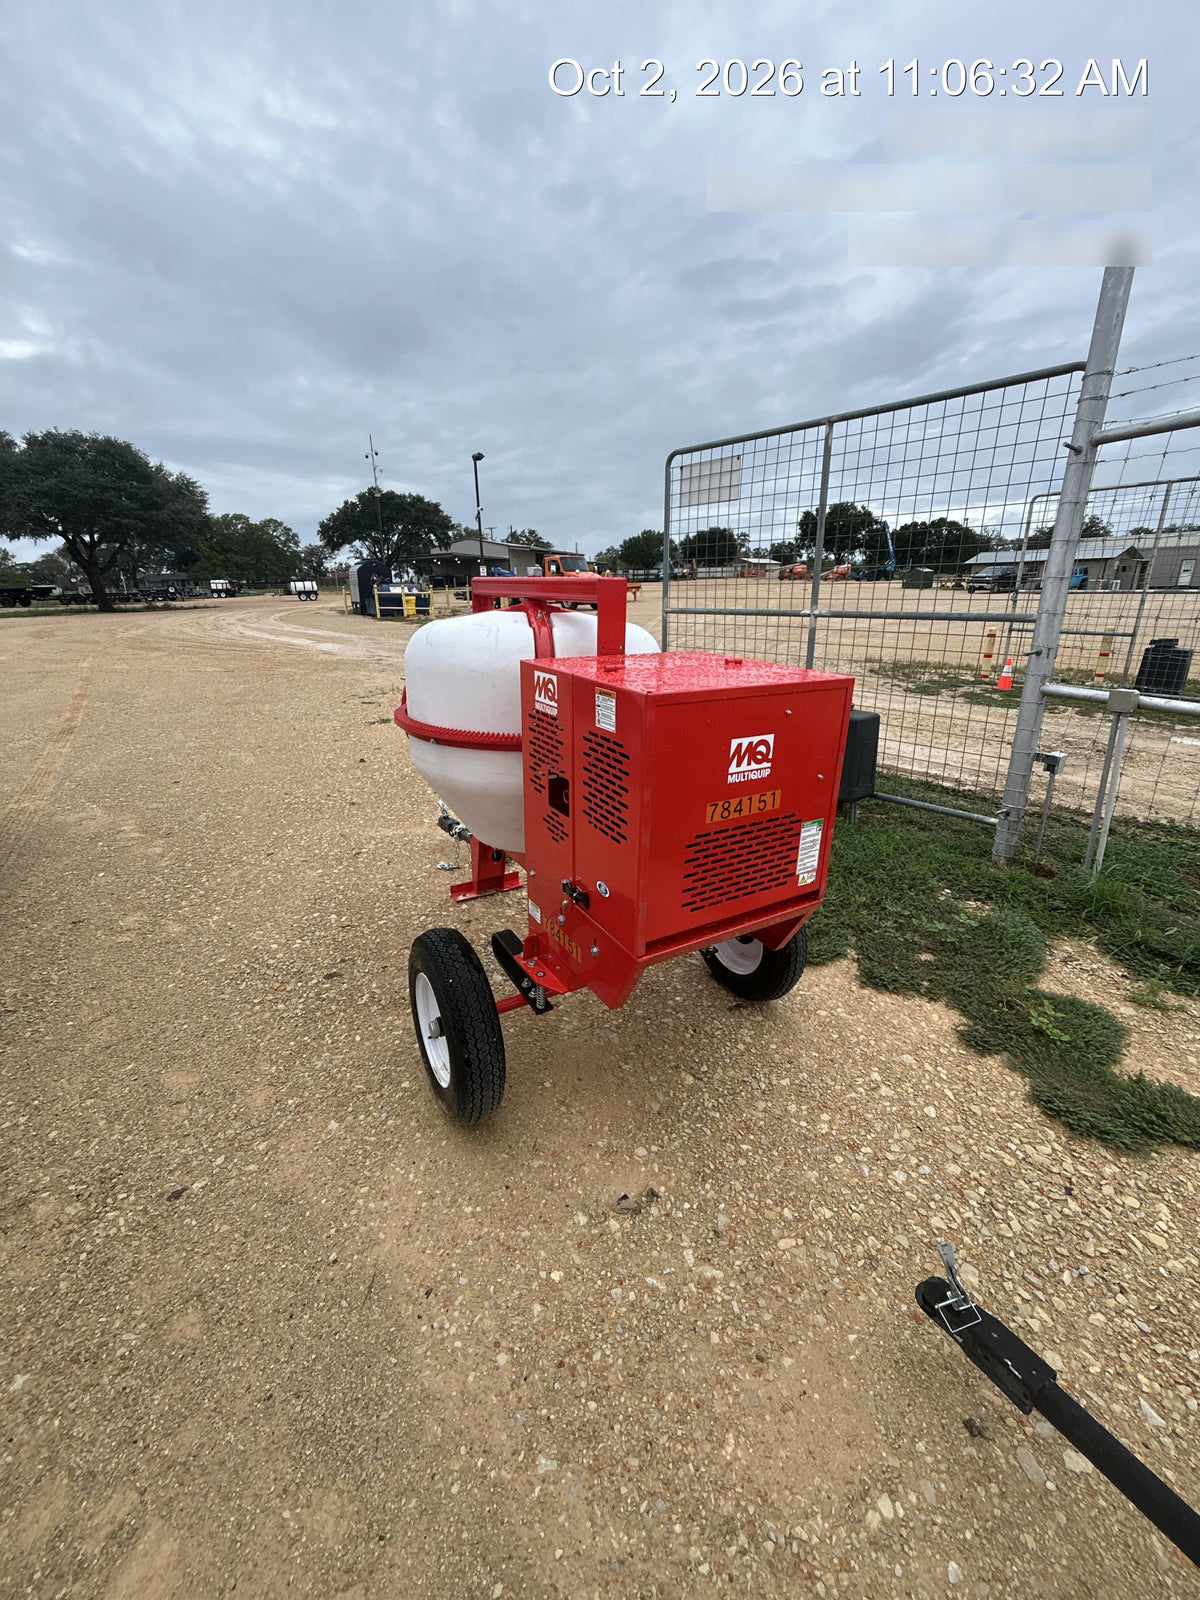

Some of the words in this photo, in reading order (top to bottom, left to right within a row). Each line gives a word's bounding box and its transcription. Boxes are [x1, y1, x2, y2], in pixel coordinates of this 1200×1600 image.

[534, 672, 558, 704] MQ
[729, 737, 773, 769] MQ
[727, 768, 771, 784] MULTIQUIP
[708, 791, 777, 822] 784151
[543, 915, 580, 961] 784151
